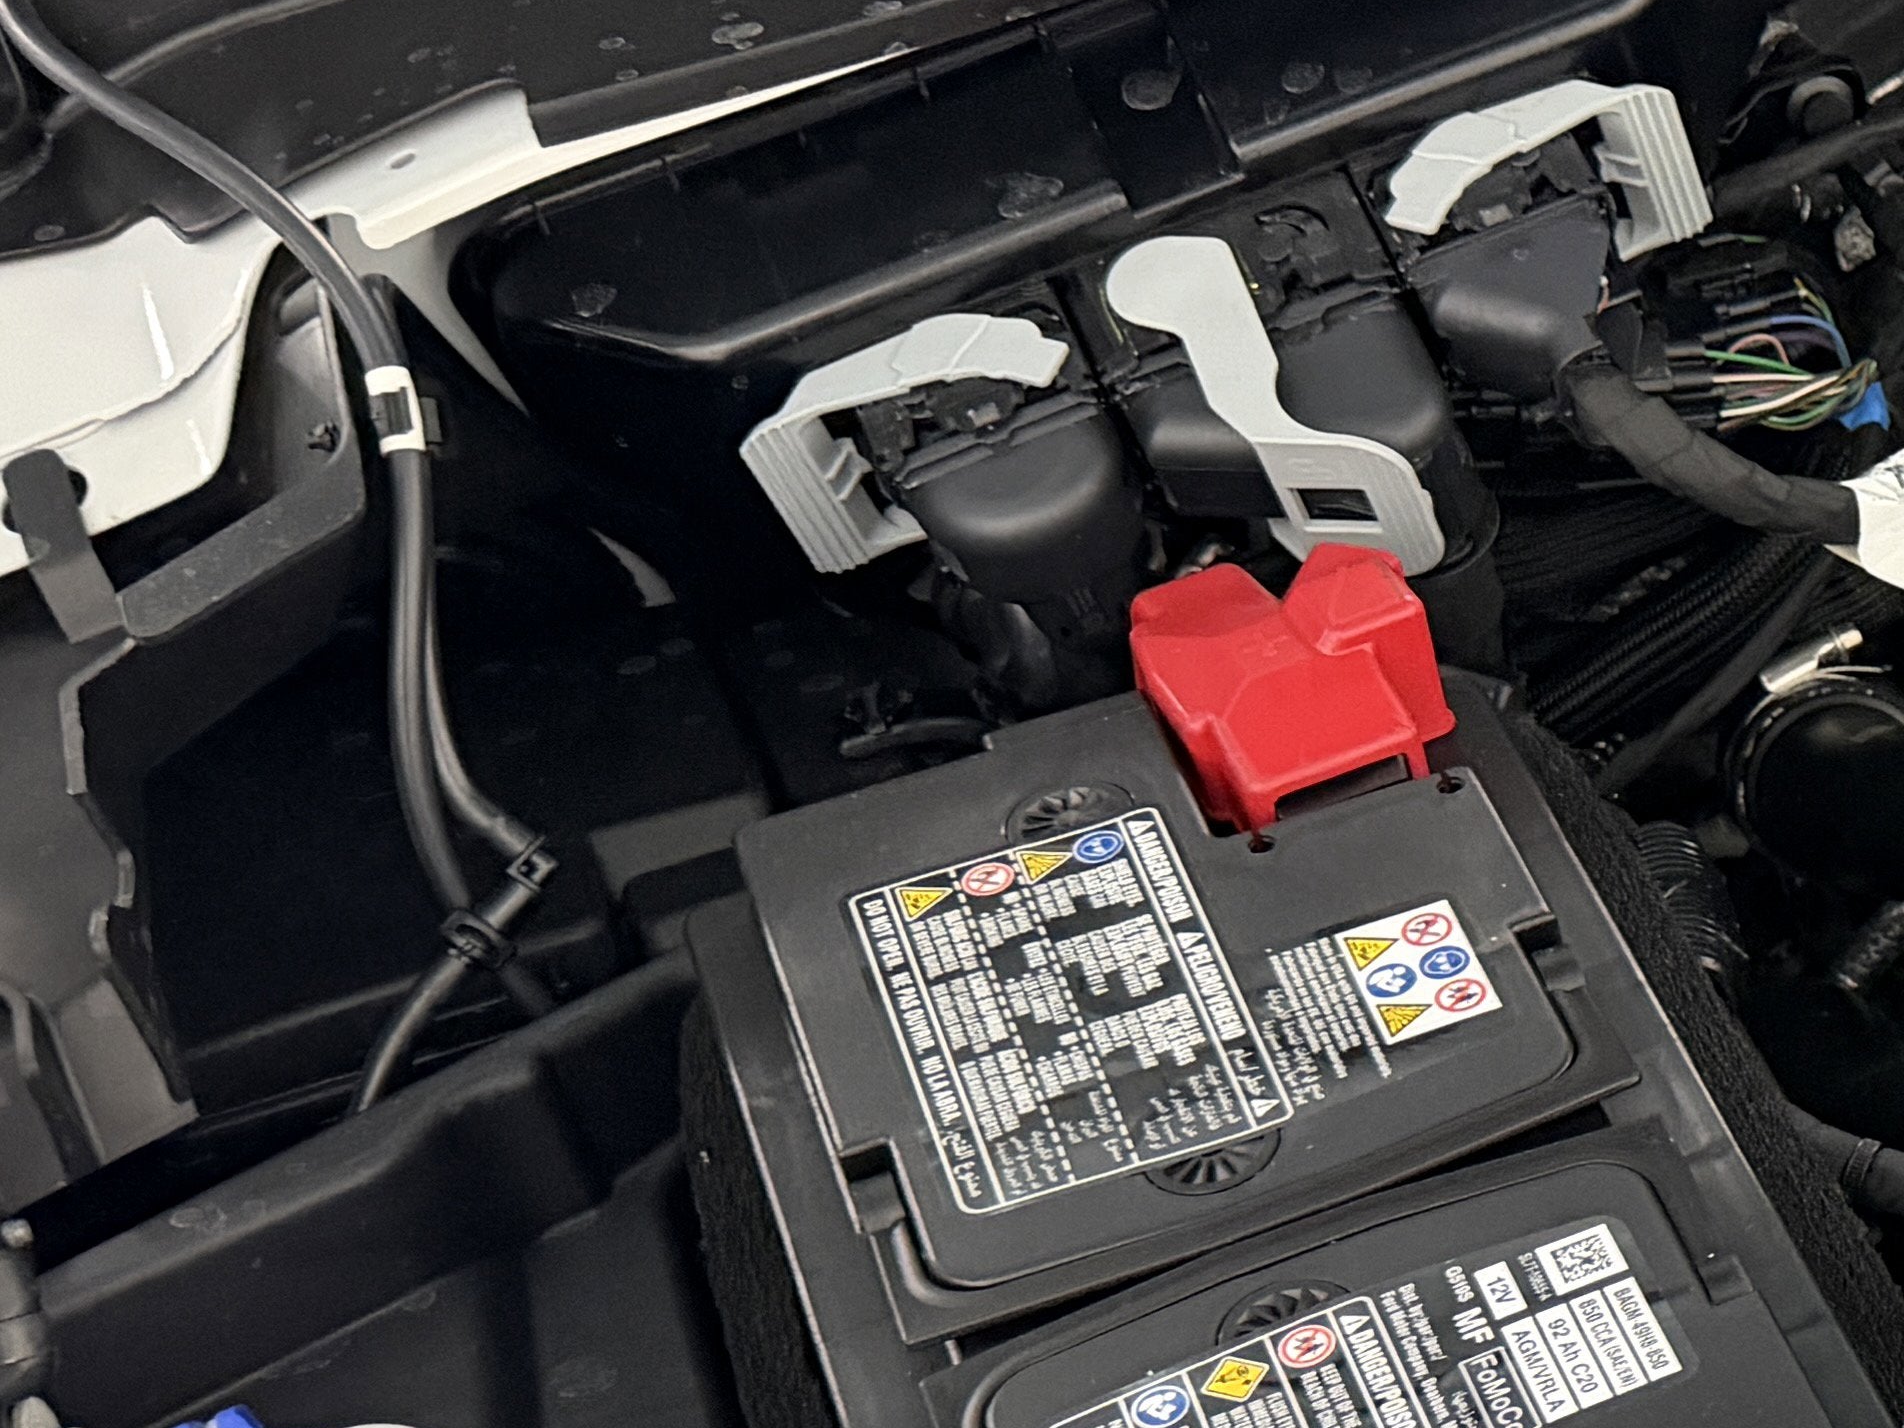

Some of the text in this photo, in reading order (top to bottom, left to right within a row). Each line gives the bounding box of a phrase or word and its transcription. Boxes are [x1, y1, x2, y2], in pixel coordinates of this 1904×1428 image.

[1133, 831, 1193, 922] DANGER/POISON
[862, 899, 886, 917] DO
[869, 915, 894, 938] NOT
[889, 972, 912, 988] NE
[1182, 944, 1246, 1040] PELIGRO/VENENO
[895, 987, 921, 1010] PAS
[920, 1056, 944, 1074] NO
[927, 1072, 950, 1090] LA
[1487, 1275, 1515, 1306] 12V
[1451, 1305, 1494, 1349] MF
[1548, 1317, 1598, 1394] 92 Ah C20
[1579, 1298, 1637, 1388] 850 CCA (SAE/EN)
[1511, 1327, 1566, 1413] AGM/VRLA
